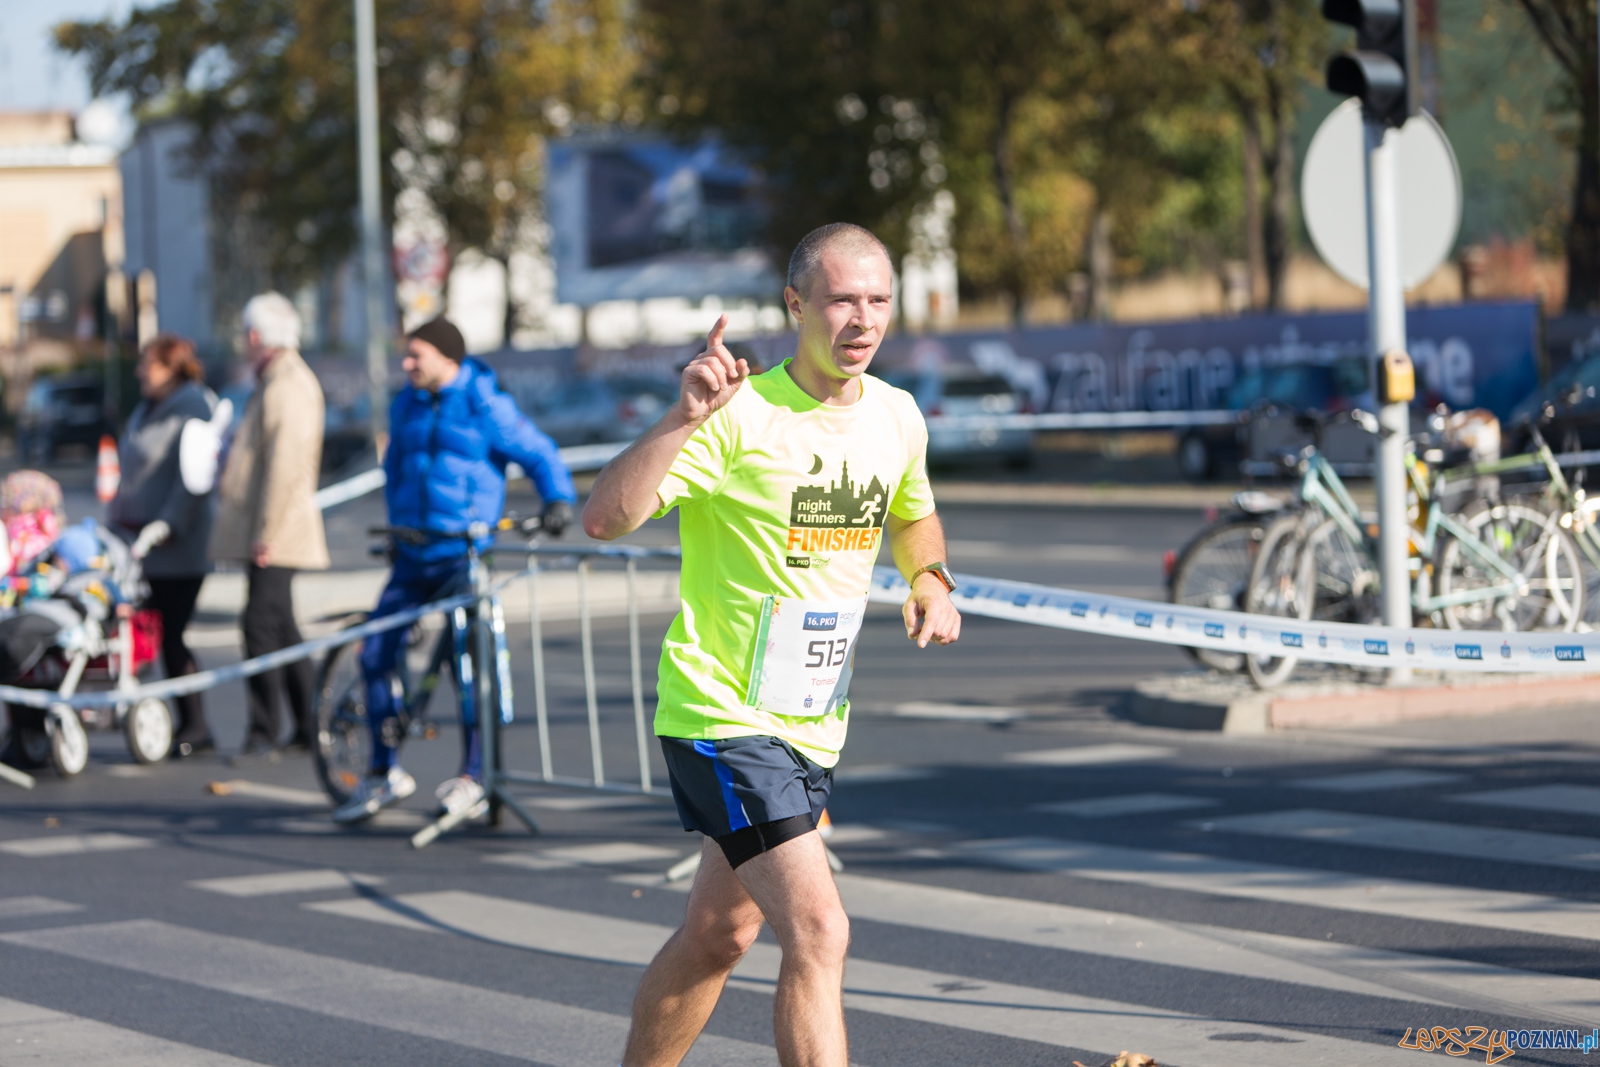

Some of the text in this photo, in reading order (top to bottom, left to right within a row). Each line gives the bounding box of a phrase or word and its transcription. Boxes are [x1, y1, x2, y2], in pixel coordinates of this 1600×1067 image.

[797, 499, 832, 514] night
[796, 514, 846, 524] runners
[787, 528, 881, 552] FINISHER
[807, 617, 819, 626] 16.
[820, 617, 836, 626] PKO
[805, 638, 848, 668] 513
[811, 677, 837, 686] Tomasz
